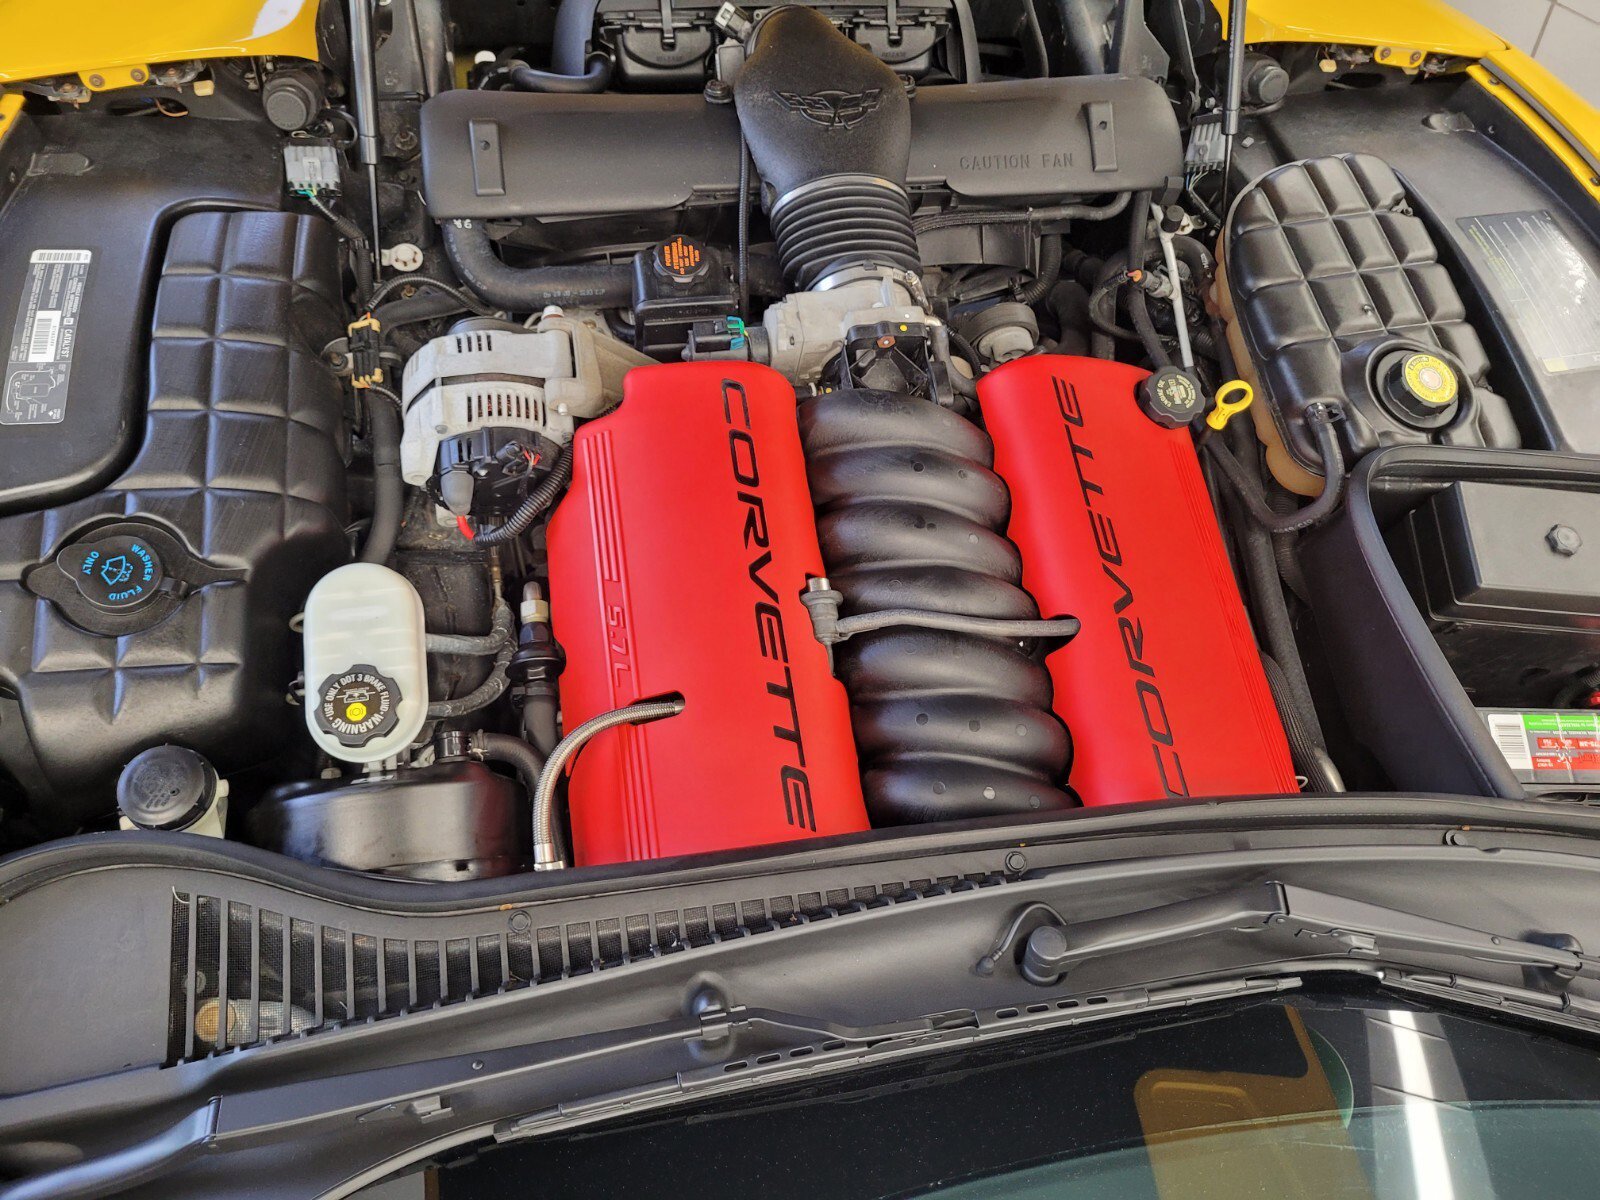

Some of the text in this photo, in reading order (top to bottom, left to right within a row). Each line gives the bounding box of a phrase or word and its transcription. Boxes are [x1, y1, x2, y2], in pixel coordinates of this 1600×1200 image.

[959, 152, 1074, 171] CAUTION FAN
[61, 328, 73, 358] CATALYST
[82, 543, 154, 601] WASHER FLUID ONLY
[1051, 375, 1190, 798] CORVETTE
[722, 377, 817, 833] CORVETTE
[607, 605, 631, 688] 5.7L
[323, 673, 390, 735] WARNING USE ONLY DOT 3 BRAKE FLUID
